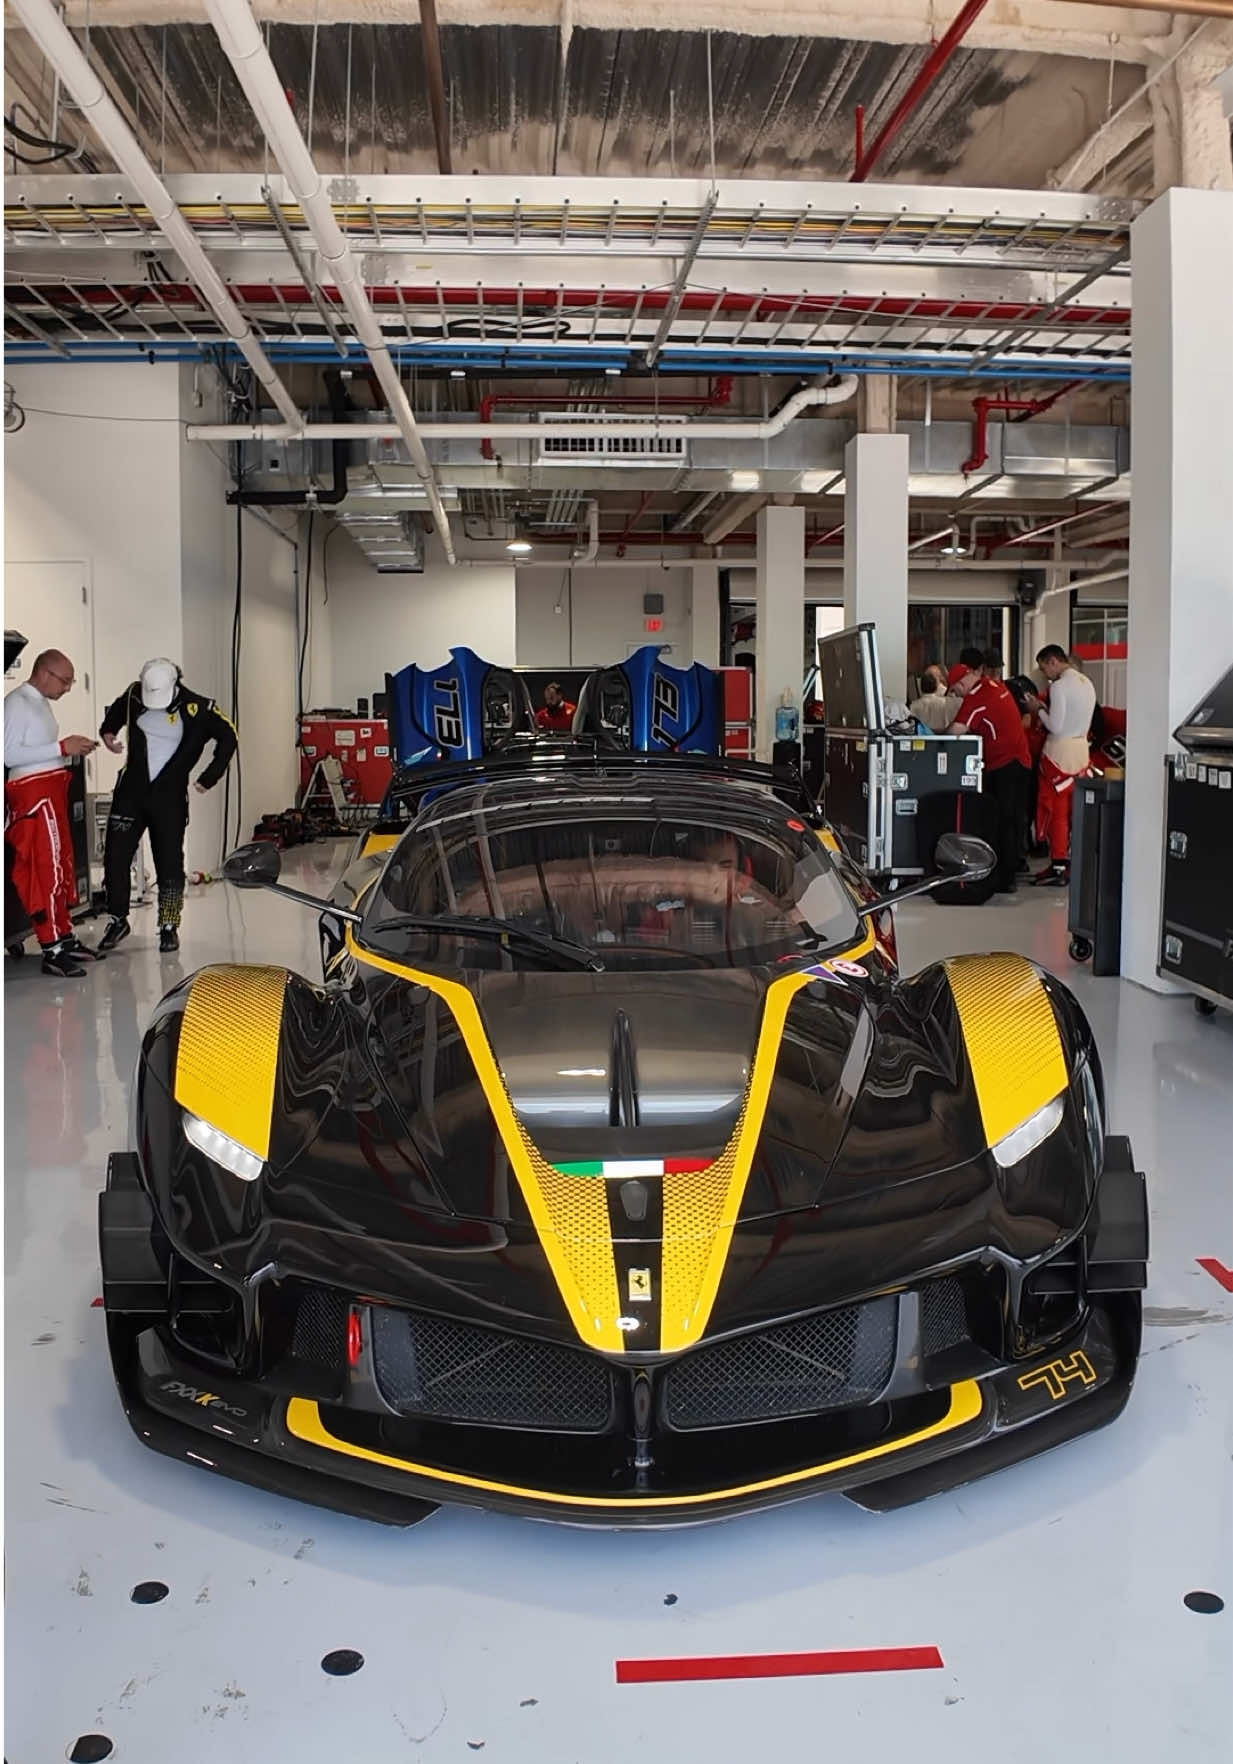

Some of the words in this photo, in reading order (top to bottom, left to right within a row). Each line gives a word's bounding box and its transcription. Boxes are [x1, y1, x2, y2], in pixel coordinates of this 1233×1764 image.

[433, 677, 465, 749] 173
[651, 672, 680, 748] 173
[1017, 1349, 1097, 1400] 74
